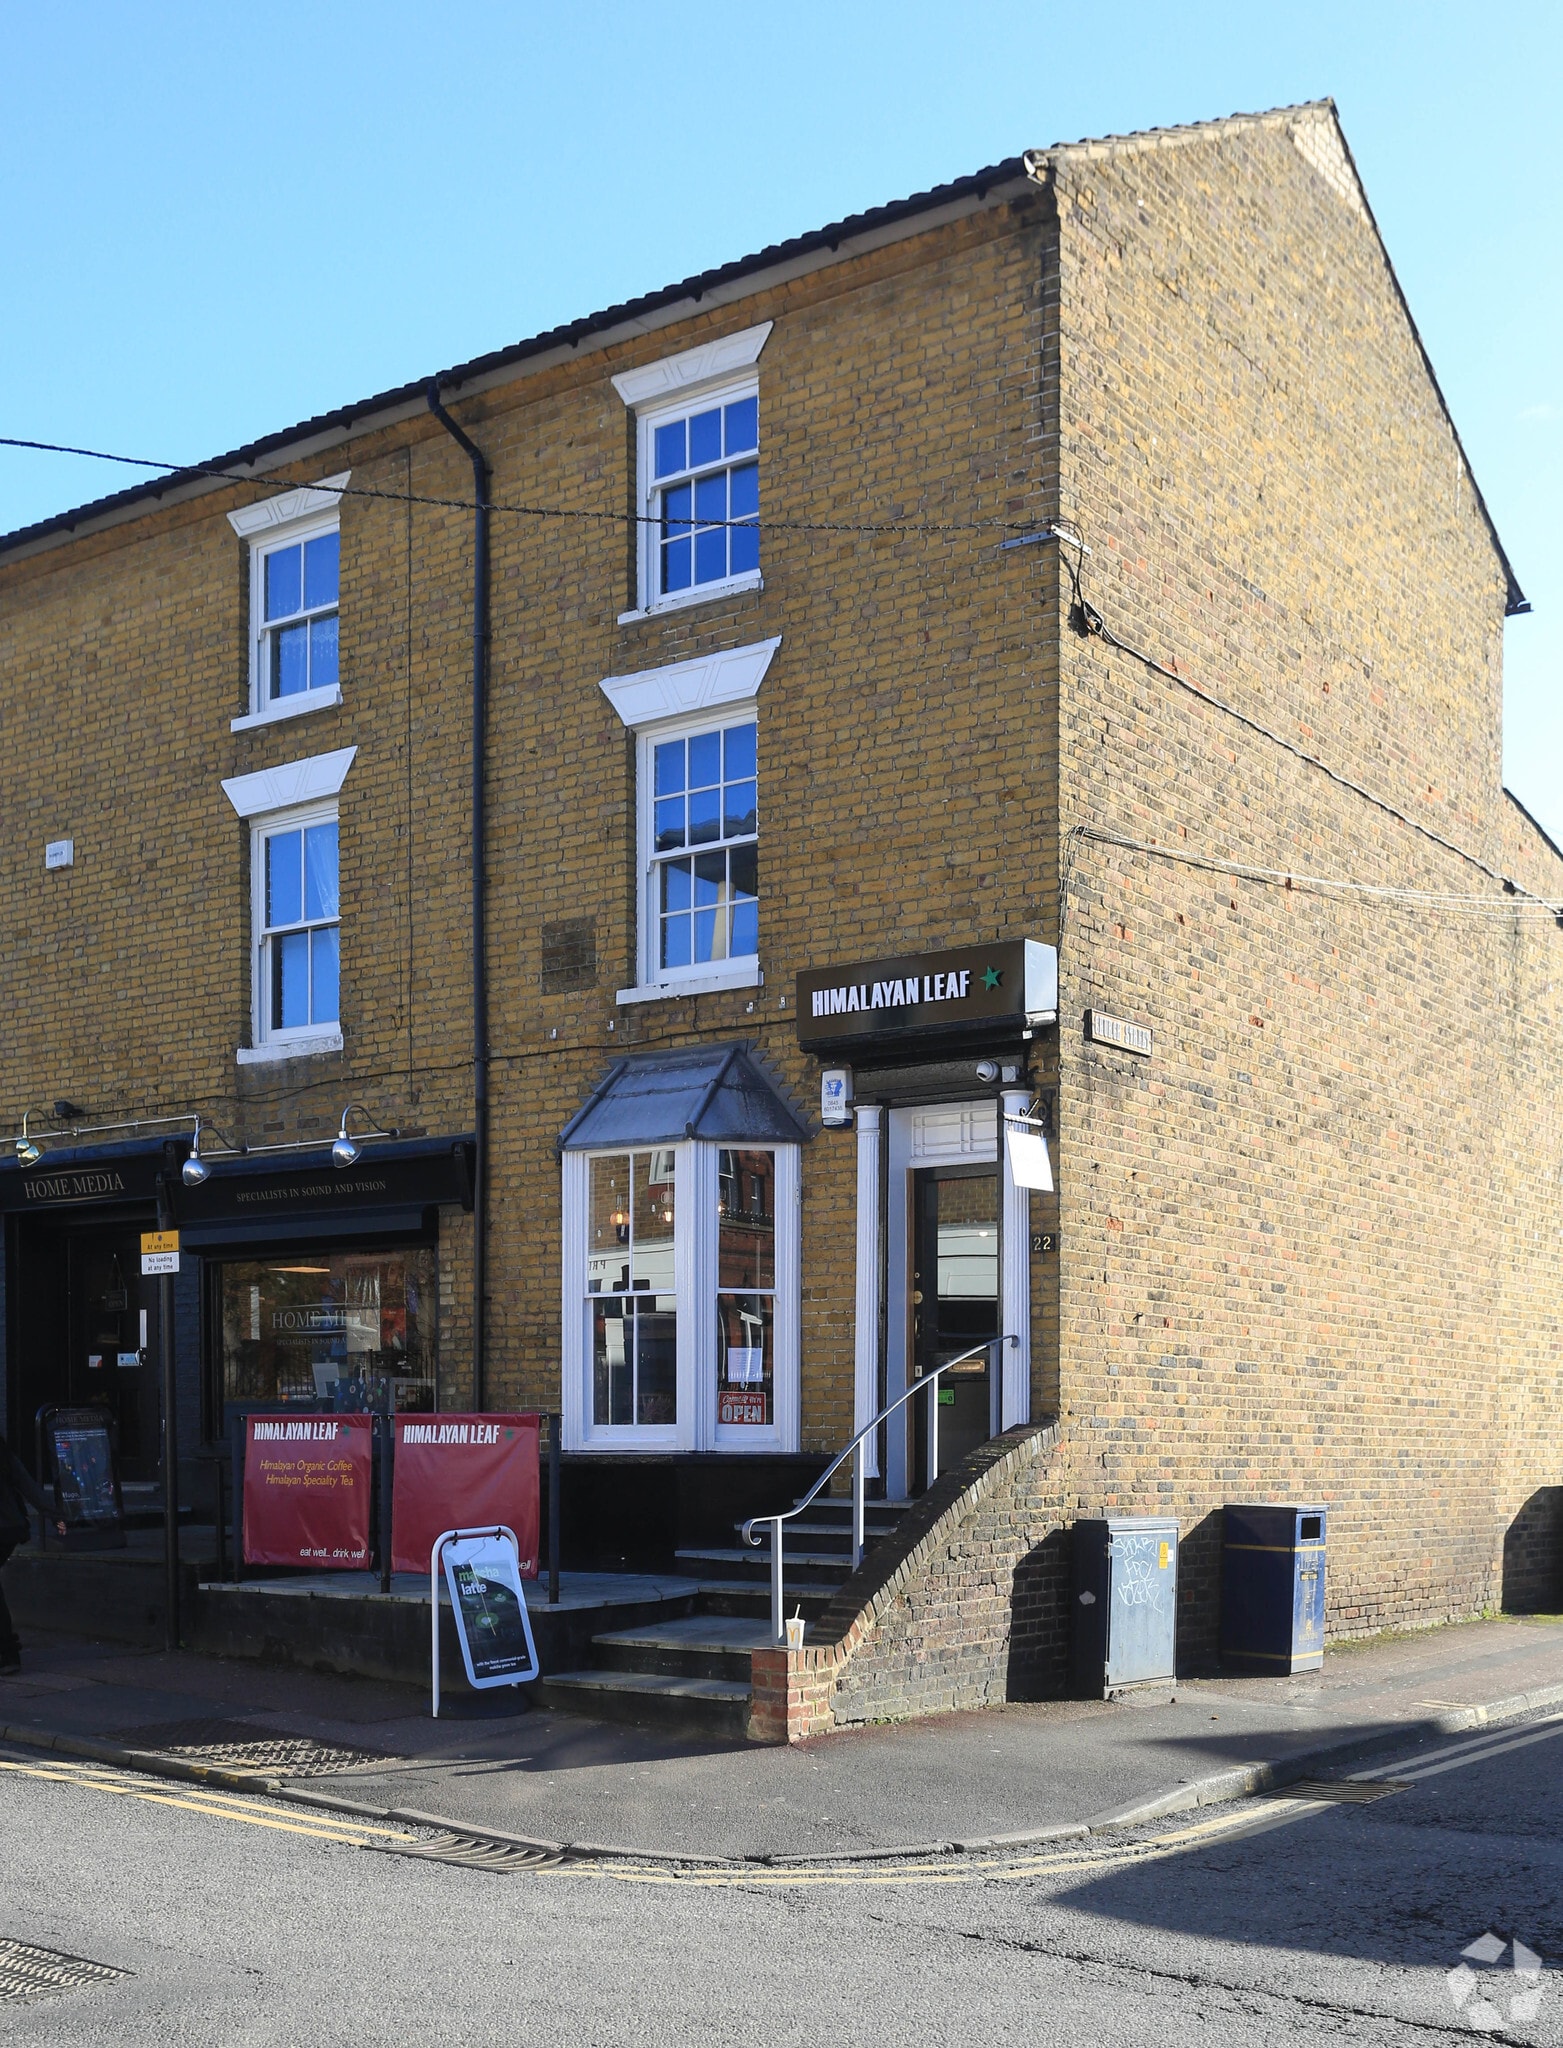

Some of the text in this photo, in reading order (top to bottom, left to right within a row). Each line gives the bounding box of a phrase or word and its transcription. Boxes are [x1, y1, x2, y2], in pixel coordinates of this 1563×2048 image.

[812, 970, 970, 1017] HIMALAYAN LEAF
[24, 1172, 125, 1199] HOME MEDIA
[236, 1180, 386, 1202] SPECIALISTS IN SOUND AND VISION
[1033, 1235, 1051, 1251] 22
[272, 1310, 320, 1329] HOME
[722, 1404, 762, 1422] OPEN
[253, 1422, 339, 1440] HIMALAYAN LEAF
[403, 1424, 500, 1444] HIMALAYAN LEAF
[260, 1460, 353, 1473] Himalayan Organic Coffee
[265, 1474, 354, 1488] Himalayan Speciality Tea
[300, 1548, 311, 1557] eat
[332, 1548, 349, 1558] drink
[351, 1549, 366, 1559] well
[518, 1560, 532, 1570] ell
[459, 1566, 500, 1582] matcha
[461, 1582, 487, 1596] latte
